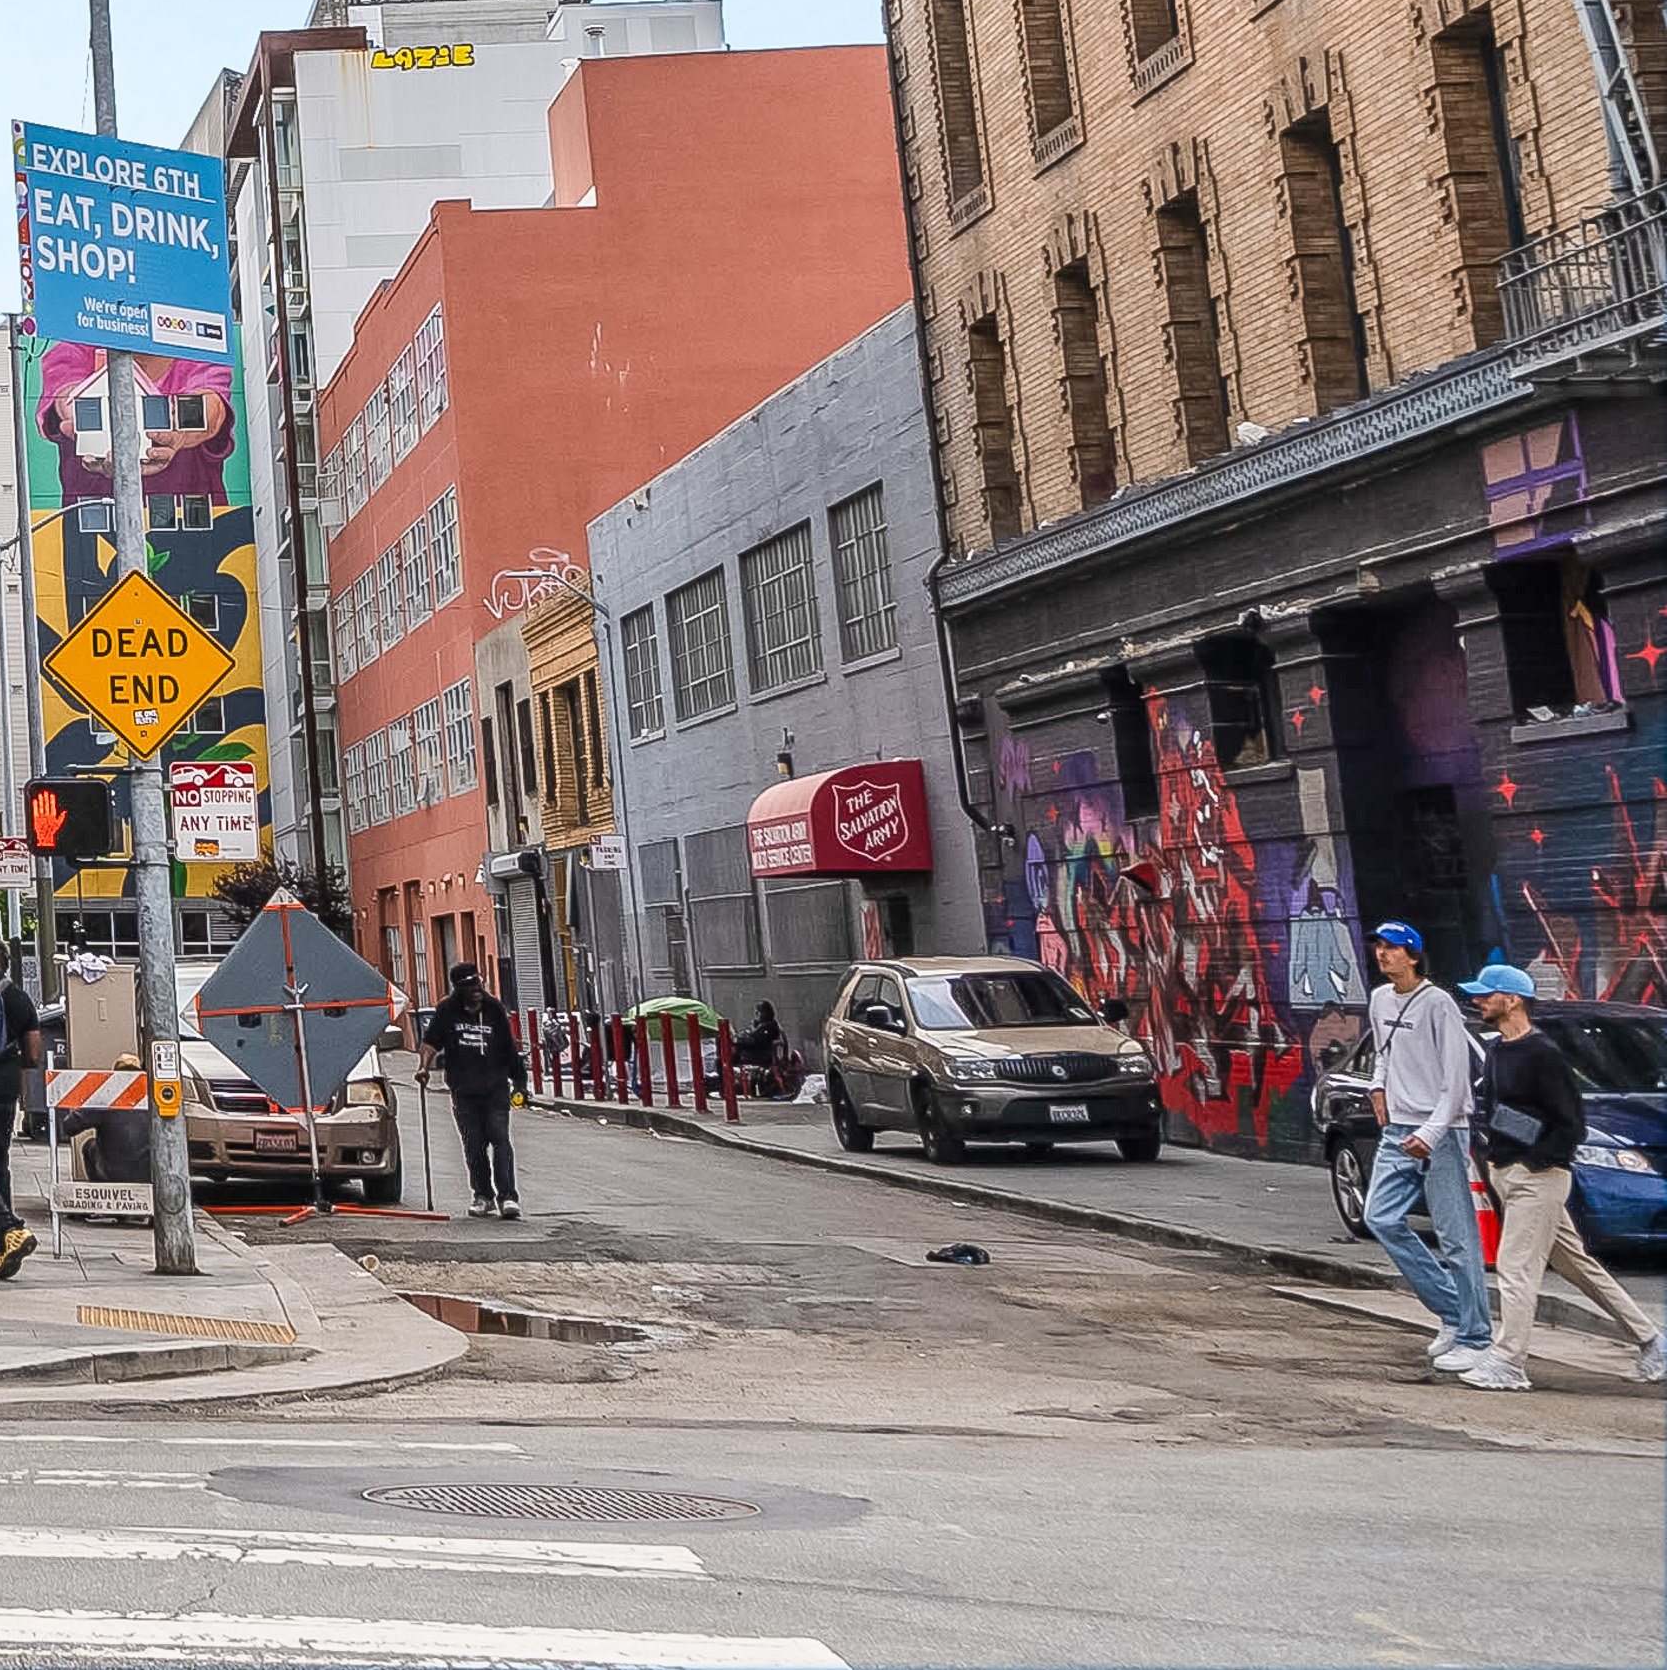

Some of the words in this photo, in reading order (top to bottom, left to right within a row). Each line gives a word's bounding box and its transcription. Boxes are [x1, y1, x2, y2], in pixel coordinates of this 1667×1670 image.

[32, 143, 147, 189] EXPLORE
[153, 167, 200, 199] 6TH
[34, 188, 102, 239] EAT,
[112, 202, 219, 260] DRINK,
[37, 235, 136, 283] SHOP!
[84, 296, 116, 313] We're
[120, 305, 148, 320] open
[77, 312, 94, 327] for
[97, 315, 149, 337] business!
[92, 628, 188, 658] DEAD
[110, 675, 179, 704] END
[174, 790, 200, 805] NO
[204, 790, 252, 803] STOPPING
[846, 789, 873, 814] THE
[180, 816, 210, 831] ANY
[216, 816, 253, 831] TIME
[840, 794, 898, 841] SALVATION
[864, 816, 899, 851] ARMY
[10, 865, 29, 874] TIME
[75, 1188, 135, 1201] ESQUIVEL
[116, 1202, 149, 1210] PAVING
